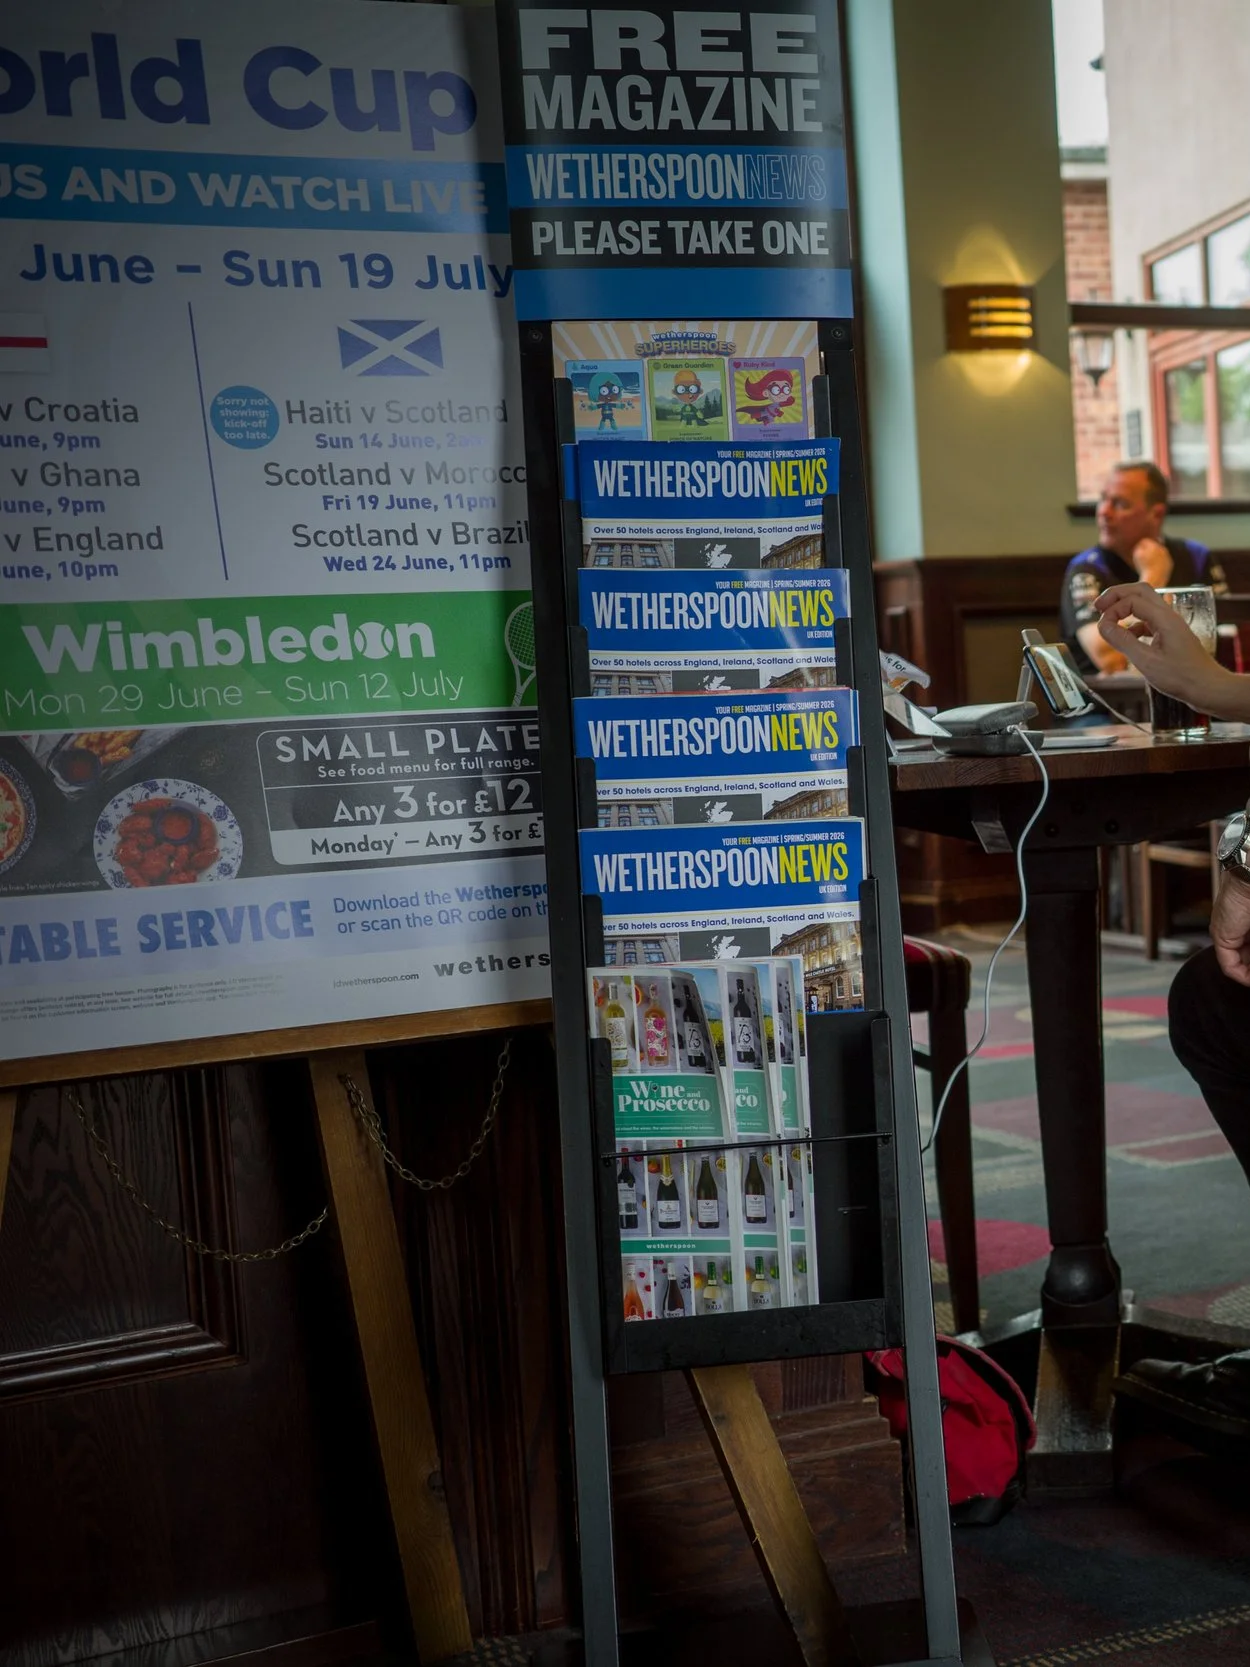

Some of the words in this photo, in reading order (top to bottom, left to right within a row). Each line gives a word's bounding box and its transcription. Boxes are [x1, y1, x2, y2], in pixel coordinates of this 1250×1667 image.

[519, 9, 818, 73] FREE
[243, 45, 477, 151] Cup
[522, 74, 823, 132] MAGAZINE
[62, 166, 176, 204] AND
[189, 172, 370, 211] WATCH
[384, 179, 488, 213] LIVE
[531, 220, 661, 256] PLEASE
[668, 220, 754, 255] TAKE
[762, 220, 829, 255] ONE
[20, 244, 154, 284] June
[223, 250, 322, 288] Sun
[340, 253, 394, 289] 19
[415, 255, 513, 298] July
[652, 331, 717, 340] wetherspoon
[635, 340, 735, 357] SUPERHEROES
[25, 397, 139, 422] Croatia
[217, 397, 246, 406] Sorry
[286, 400, 351, 425] Haiti
[364, 406, 375, 423] v
[387, 400, 507, 425] Scotland
[224, 420, 266, 428] kick-off
[246, 431, 270, 439] late.
[53, 432, 100, 451] 9pm
[315, 432, 353, 450] Sun
[359, 433, 383, 449] 14
[388, 432, 441, 450] June,
[11, 469, 28, 486] v
[40, 462, 140, 487] Ghana
[264, 462, 391, 487] Scotland
[401, 468, 415, 485] v
[58, 497, 105, 516] 9pm
[322, 494, 351, 512] Fri
[357, 493, 379, 511] 19
[385, 493, 439, 513] June,
[444, 492, 496, 514] 11pm
[4, 534, 21, 552] v
[33, 526, 163, 558] England
[292, 524, 419, 548] Scotland
[427, 530, 441, 546] v
[452, 520, 529, 545] Brazil
[594, 527, 614, 535] Over
[629, 526, 654, 534] hotels
[686, 526, 722, 536] England,
[724, 526, 756, 535] Ireland,
[758, 525, 792, 534] Scotland
[795, 525, 809, 533] and
[58, 561, 119, 580] 10pm
[323, 555, 367, 573] Wed
[371, 555, 396, 572] 24
[401, 554, 454, 574] June,
[459, 553, 511, 574] 11pm
[716, 581, 730, 589] YOUR
[731, 581, 743, 589] FREE
[745, 580, 770, 589] MAGAZINE
[774, 580, 816, 588] SPRING/SUMMER
[817, 579, 830, 587] 2026
[21, 613, 435, 674] Wimbledon
[592, 658, 611, 666] Over
[614, 658, 624, 666] 50
[626, 658, 651, 667] hotels
[684, 658, 721, 668] England,
[723, 657, 755, 667] Ireland,
[757, 657, 793, 665] Scotland
[796, 656, 811, 664] and
[892, 661, 906, 672] for
[4, 687, 86, 717] Mon
[100, 683, 144, 713] 29
[158, 681, 243, 711] June
[285, 675, 348, 703] Sun
[360, 673, 388, 700] 12
[402, 671, 464, 701] July
[716, 706, 730, 714] YOUR
[732, 705, 744, 714] FREE
[745, 704, 772, 713] MAGAZINE
[776, 702, 819, 712] SPRING/SUMMER
[821, 700, 834, 709] 2026
[276, 730, 409, 763] SMALL
[425, 723, 540, 754] PLATE
[318, 764, 346, 779] See
[351, 761, 385, 776] food
[389, 763, 430, 774] menu
[435, 758, 456, 772] for
[462, 757, 484, 771] full
[488, 756, 535, 773] range.
[613, 788, 623, 796] 50
[626, 787, 652, 795] hotels
[654, 786, 682, 794] across
[685, 784, 722, 793] England,
[724, 783, 757, 792] Ireland,
[759, 782, 797, 790] Scotland
[800, 780, 816, 788] and
[818, 778, 845, 786] Wales.
[333, 800, 385, 824] Any
[393, 786, 419, 818] 3
[427, 793, 467, 816] for
[474, 779, 534, 811] £12
[426, 828, 463, 850] Any
[469, 821, 486, 844] 3
[493, 825, 523, 841] for
[722, 837, 737, 846] YOUR
[739, 836, 751, 845] FREE
[752, 835, 779, 844] MAGAZINE
[784, 833, 828, 843] SPRING/SUMMER
[830, 832, 844, 840] 2026
[333, 892, 419, 913] Download
[425, 890, 451, 905] the
[338, 921, 355, 934] or
[362, 917, 401, 932] scan
[405, 914, 433, 928] the
[438, 910, 463, 925] QR
[468, 906, 507, 922] code
[512, 905, 532, 917] on
[631, 922, 657, 930] hotels
[660, 920, 688, 928] across
[692, 918, 730, 927] England,
[732, 916, 765, 926] Ireland,
[767, 914, 805, 922] Scotland
[808, 912, 824, 920] and
[827, 910, 854, 919] Wales.
[0, 917, 120, 966] ABLE
[137, 900, 314, 953] SERVICE
[333, 972, 419, 988] jdwetherspoon.com
[433, 953, 551, 976] wethers
[618, 1093, 710, 1113] Prosecco
